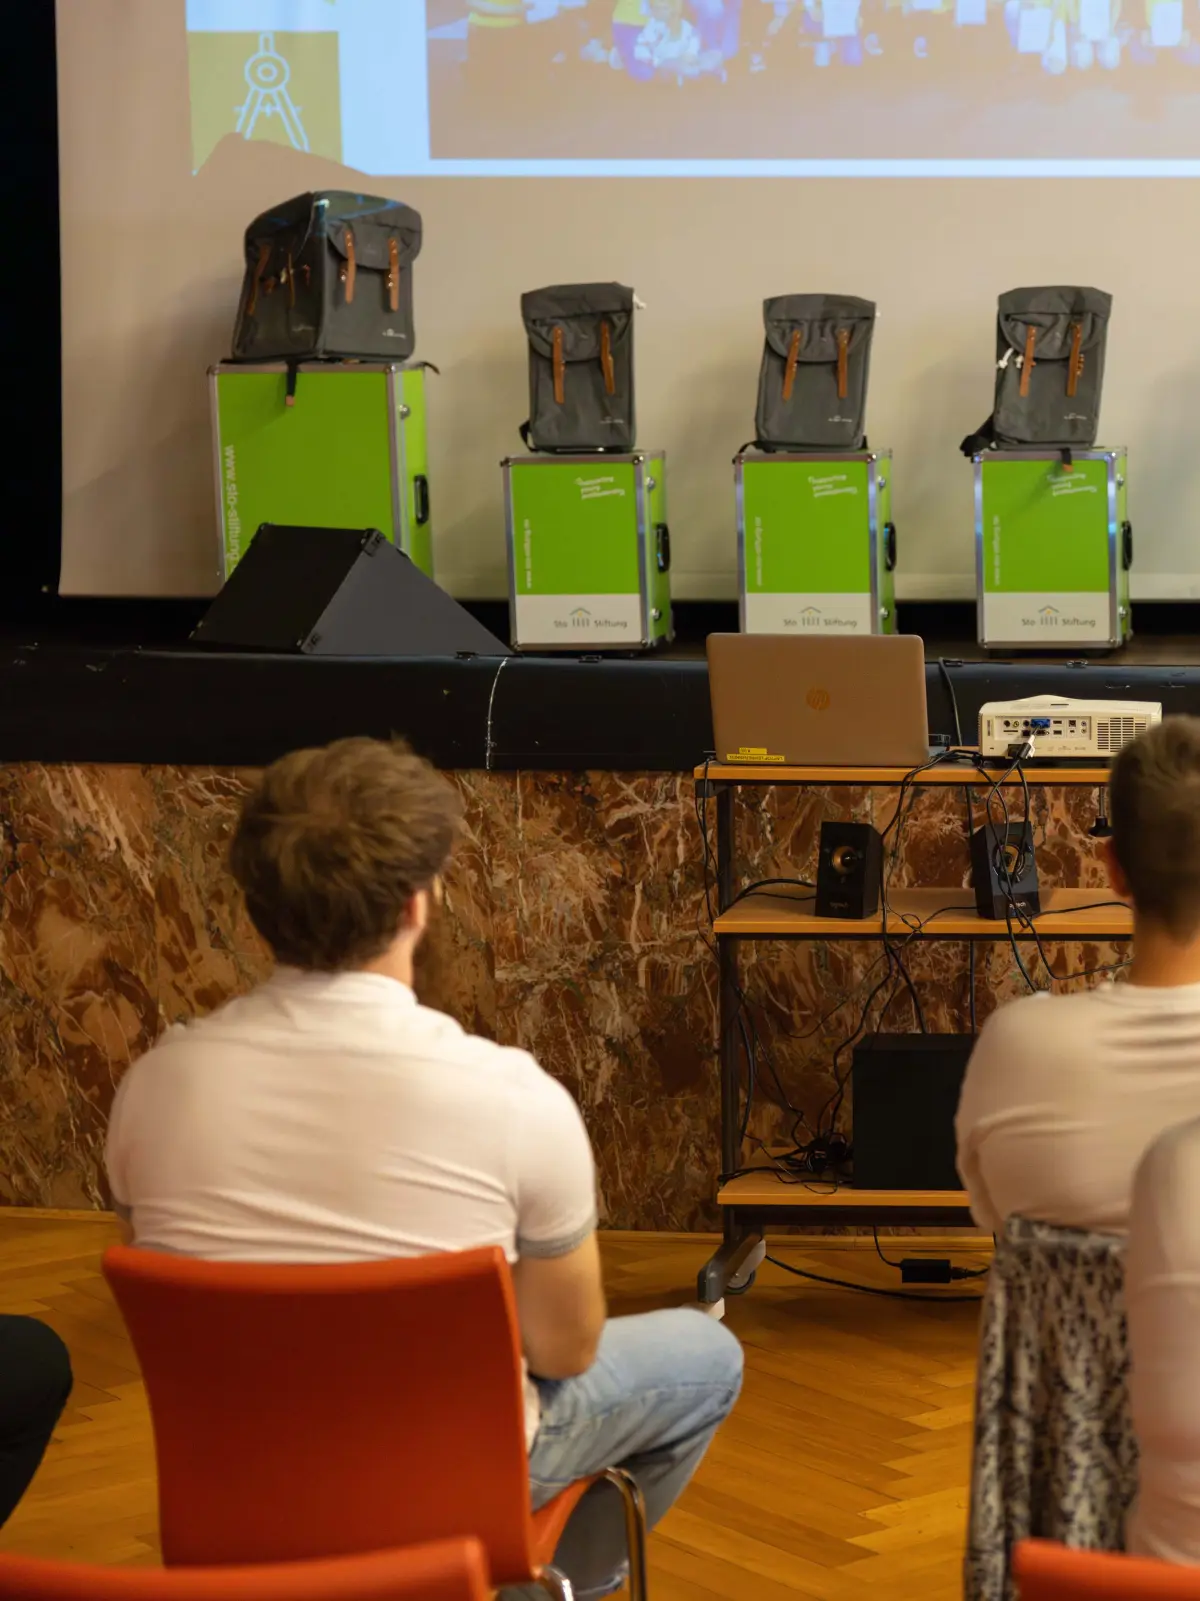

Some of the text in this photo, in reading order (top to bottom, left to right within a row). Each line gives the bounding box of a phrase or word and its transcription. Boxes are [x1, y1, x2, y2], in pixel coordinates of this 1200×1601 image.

[594, 619, 628, 629] Stiftung
[783, 618, 857, 629] Sto Stiftung
[1021, 617, 1096, 628] Sto Stiftung
